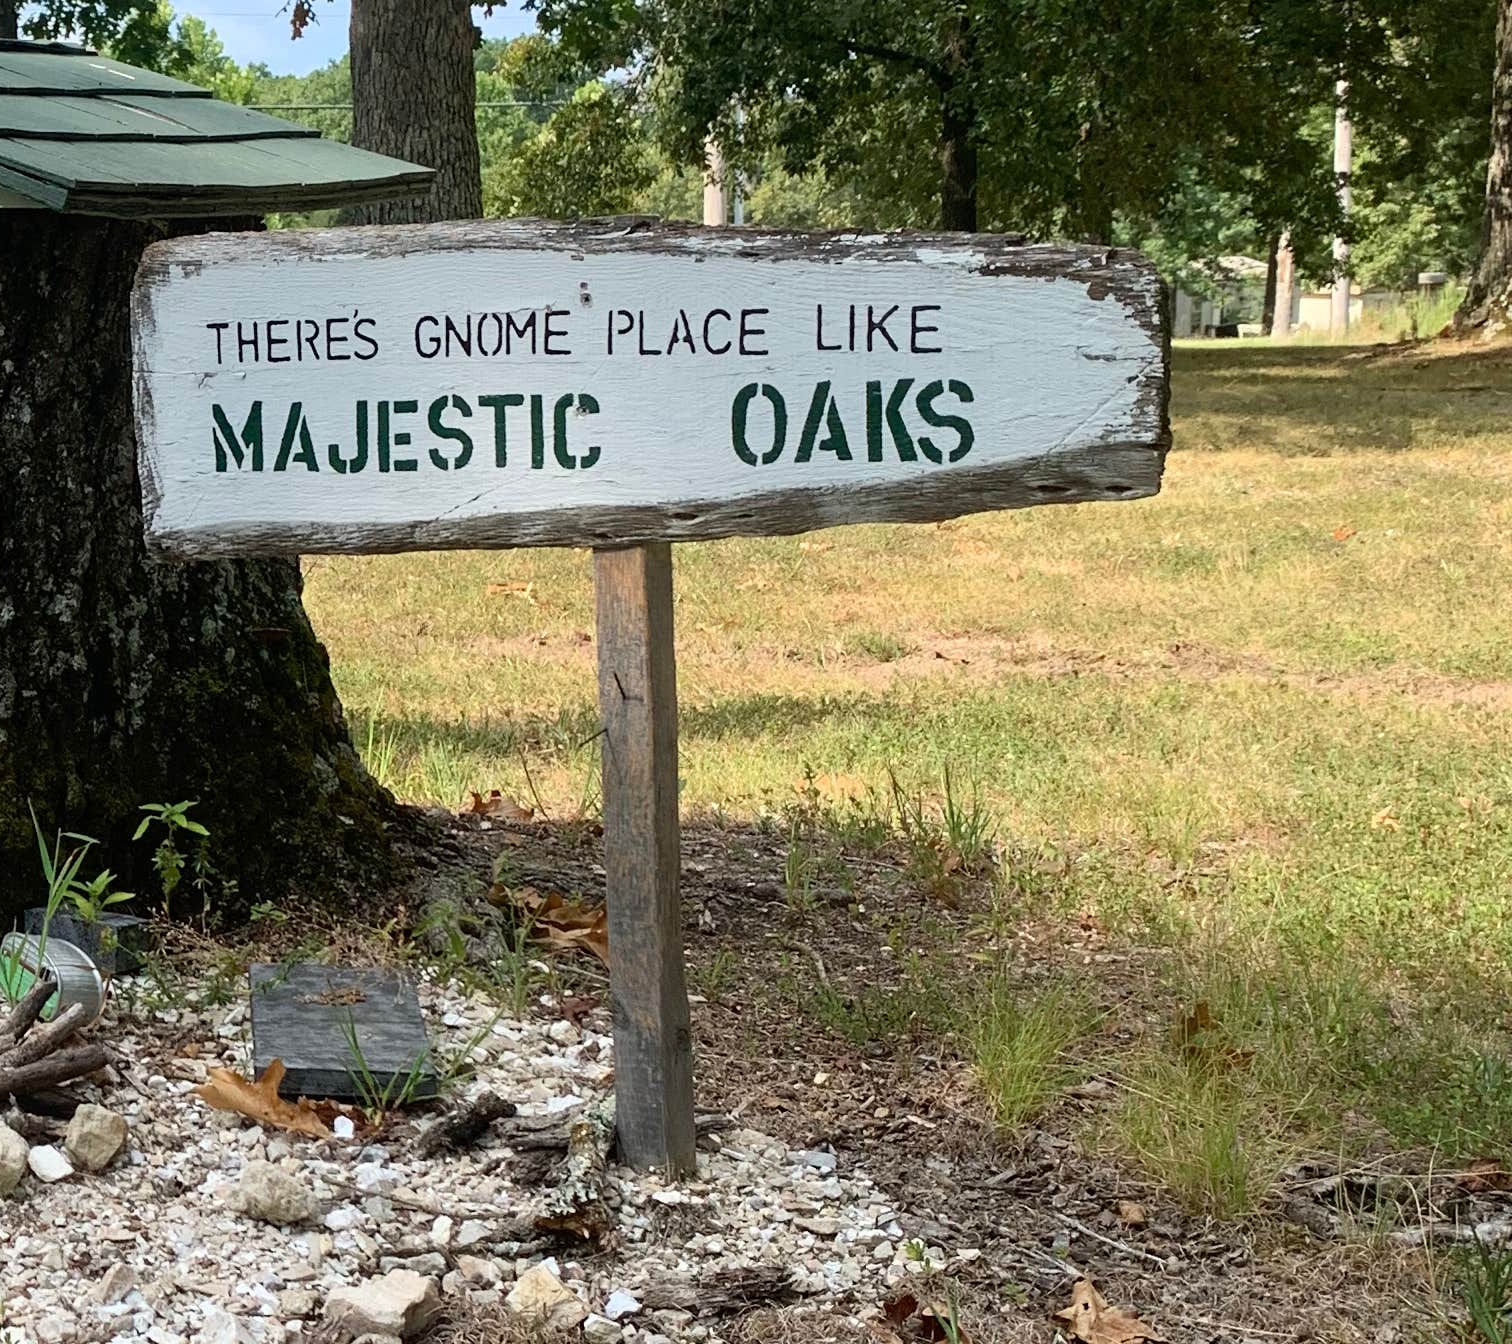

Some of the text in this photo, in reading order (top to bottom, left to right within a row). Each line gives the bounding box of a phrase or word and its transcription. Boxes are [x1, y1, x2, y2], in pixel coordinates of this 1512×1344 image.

[205, 303, 943, 365] THERE'S GNOME PLACE LIKE
[211, 377, 975, 475] MAJESTIC OAKS
